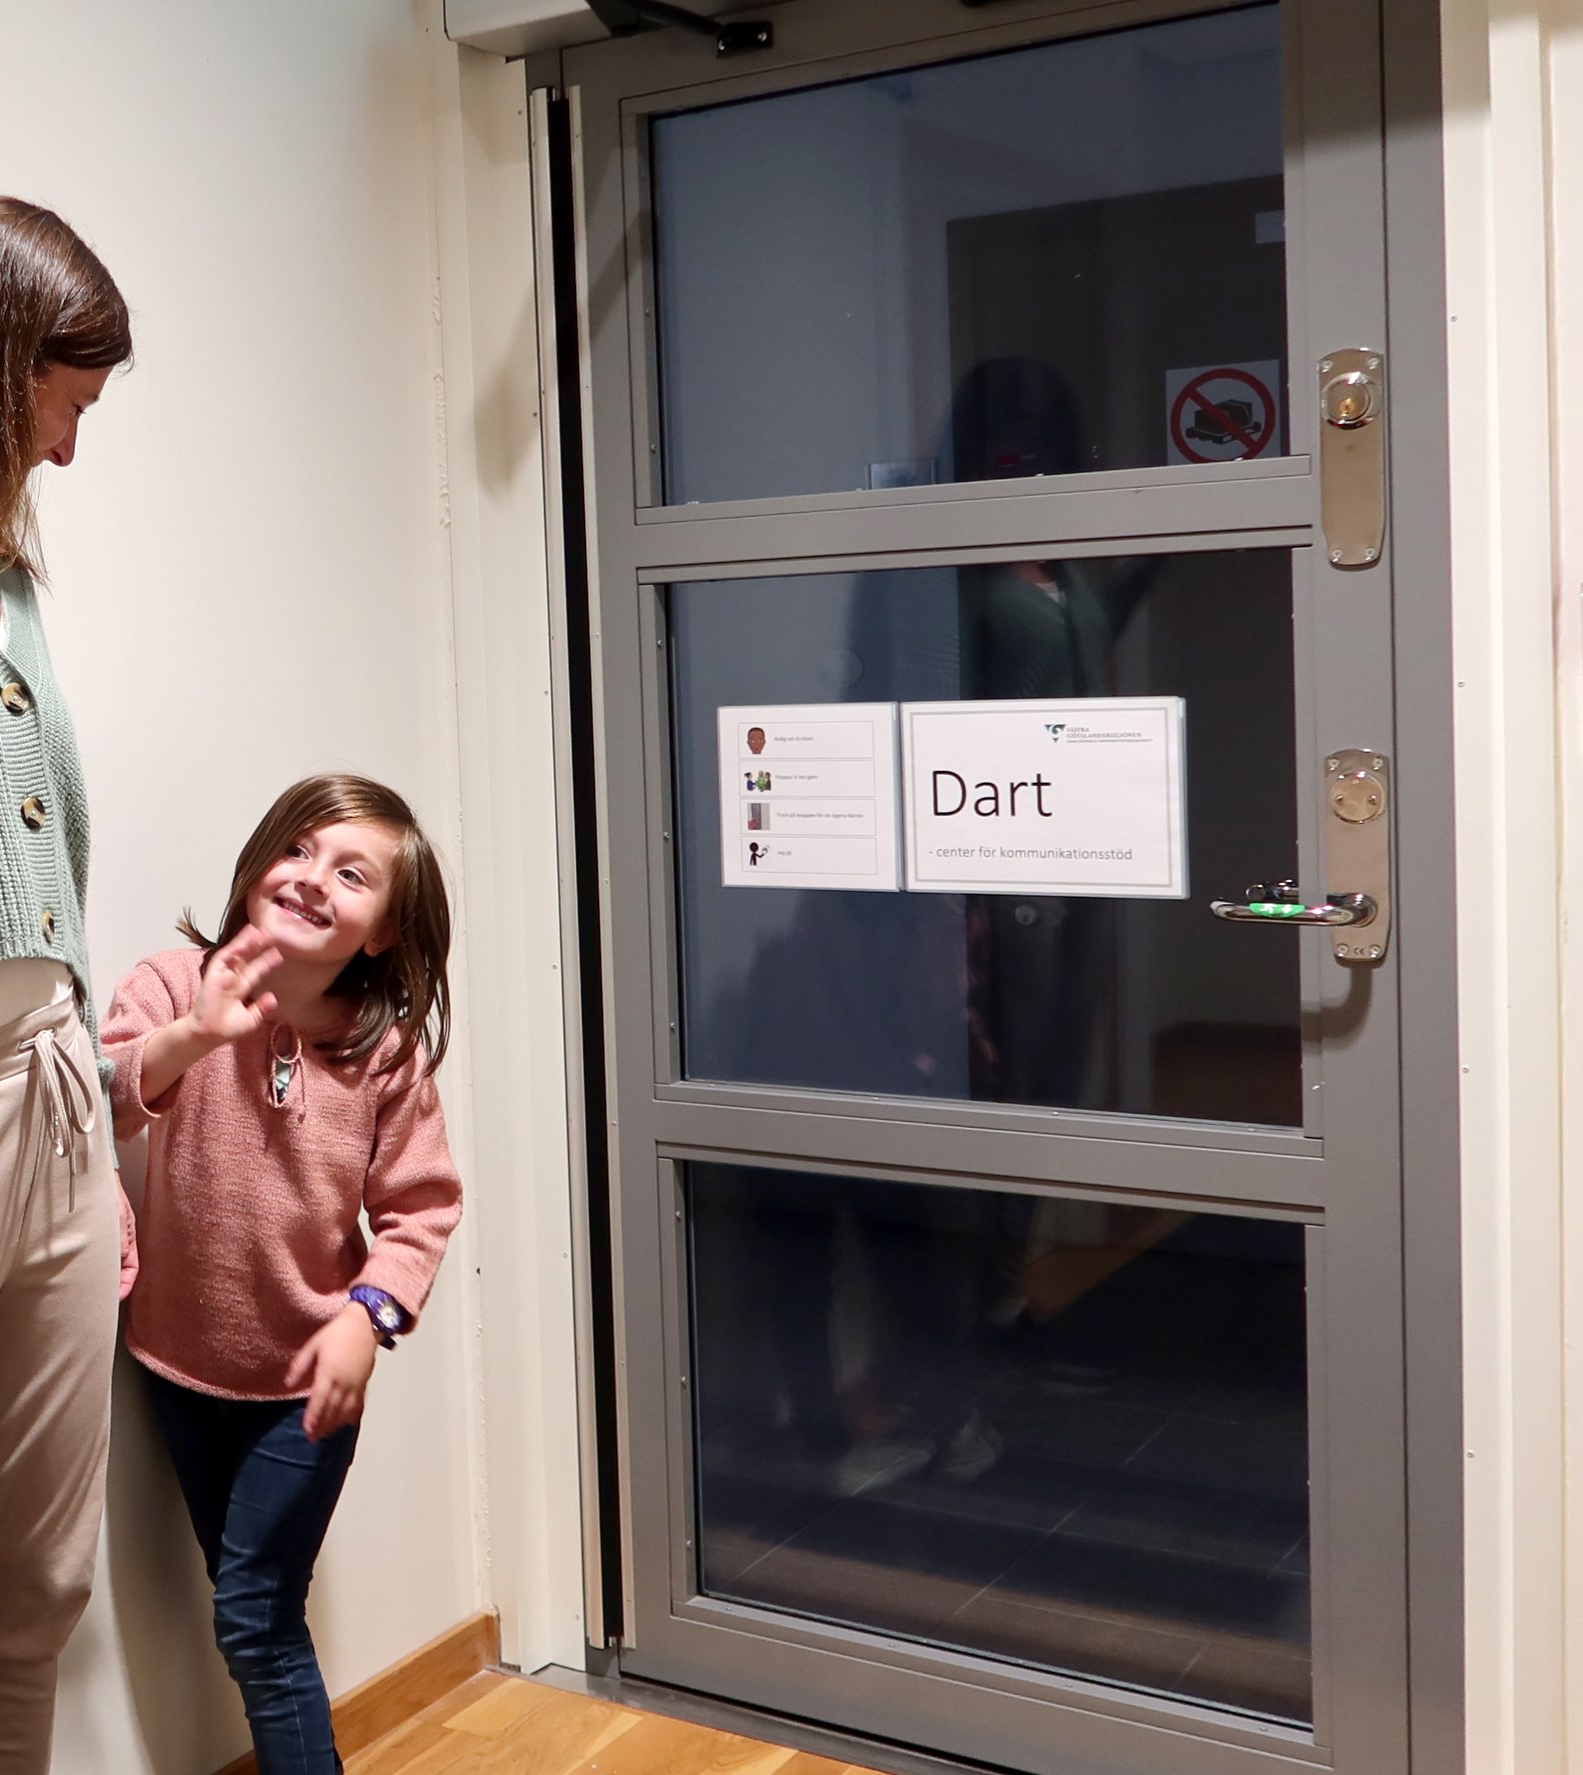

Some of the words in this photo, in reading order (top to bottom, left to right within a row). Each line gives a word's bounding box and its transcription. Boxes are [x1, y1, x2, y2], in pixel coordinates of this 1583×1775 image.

[932, 770, 1053, 817] Dart
[936, 848, 975, 857] center
[979, 846, 995, 858] för
[1000, 847, 1133, 860] kommunikationsstöd
